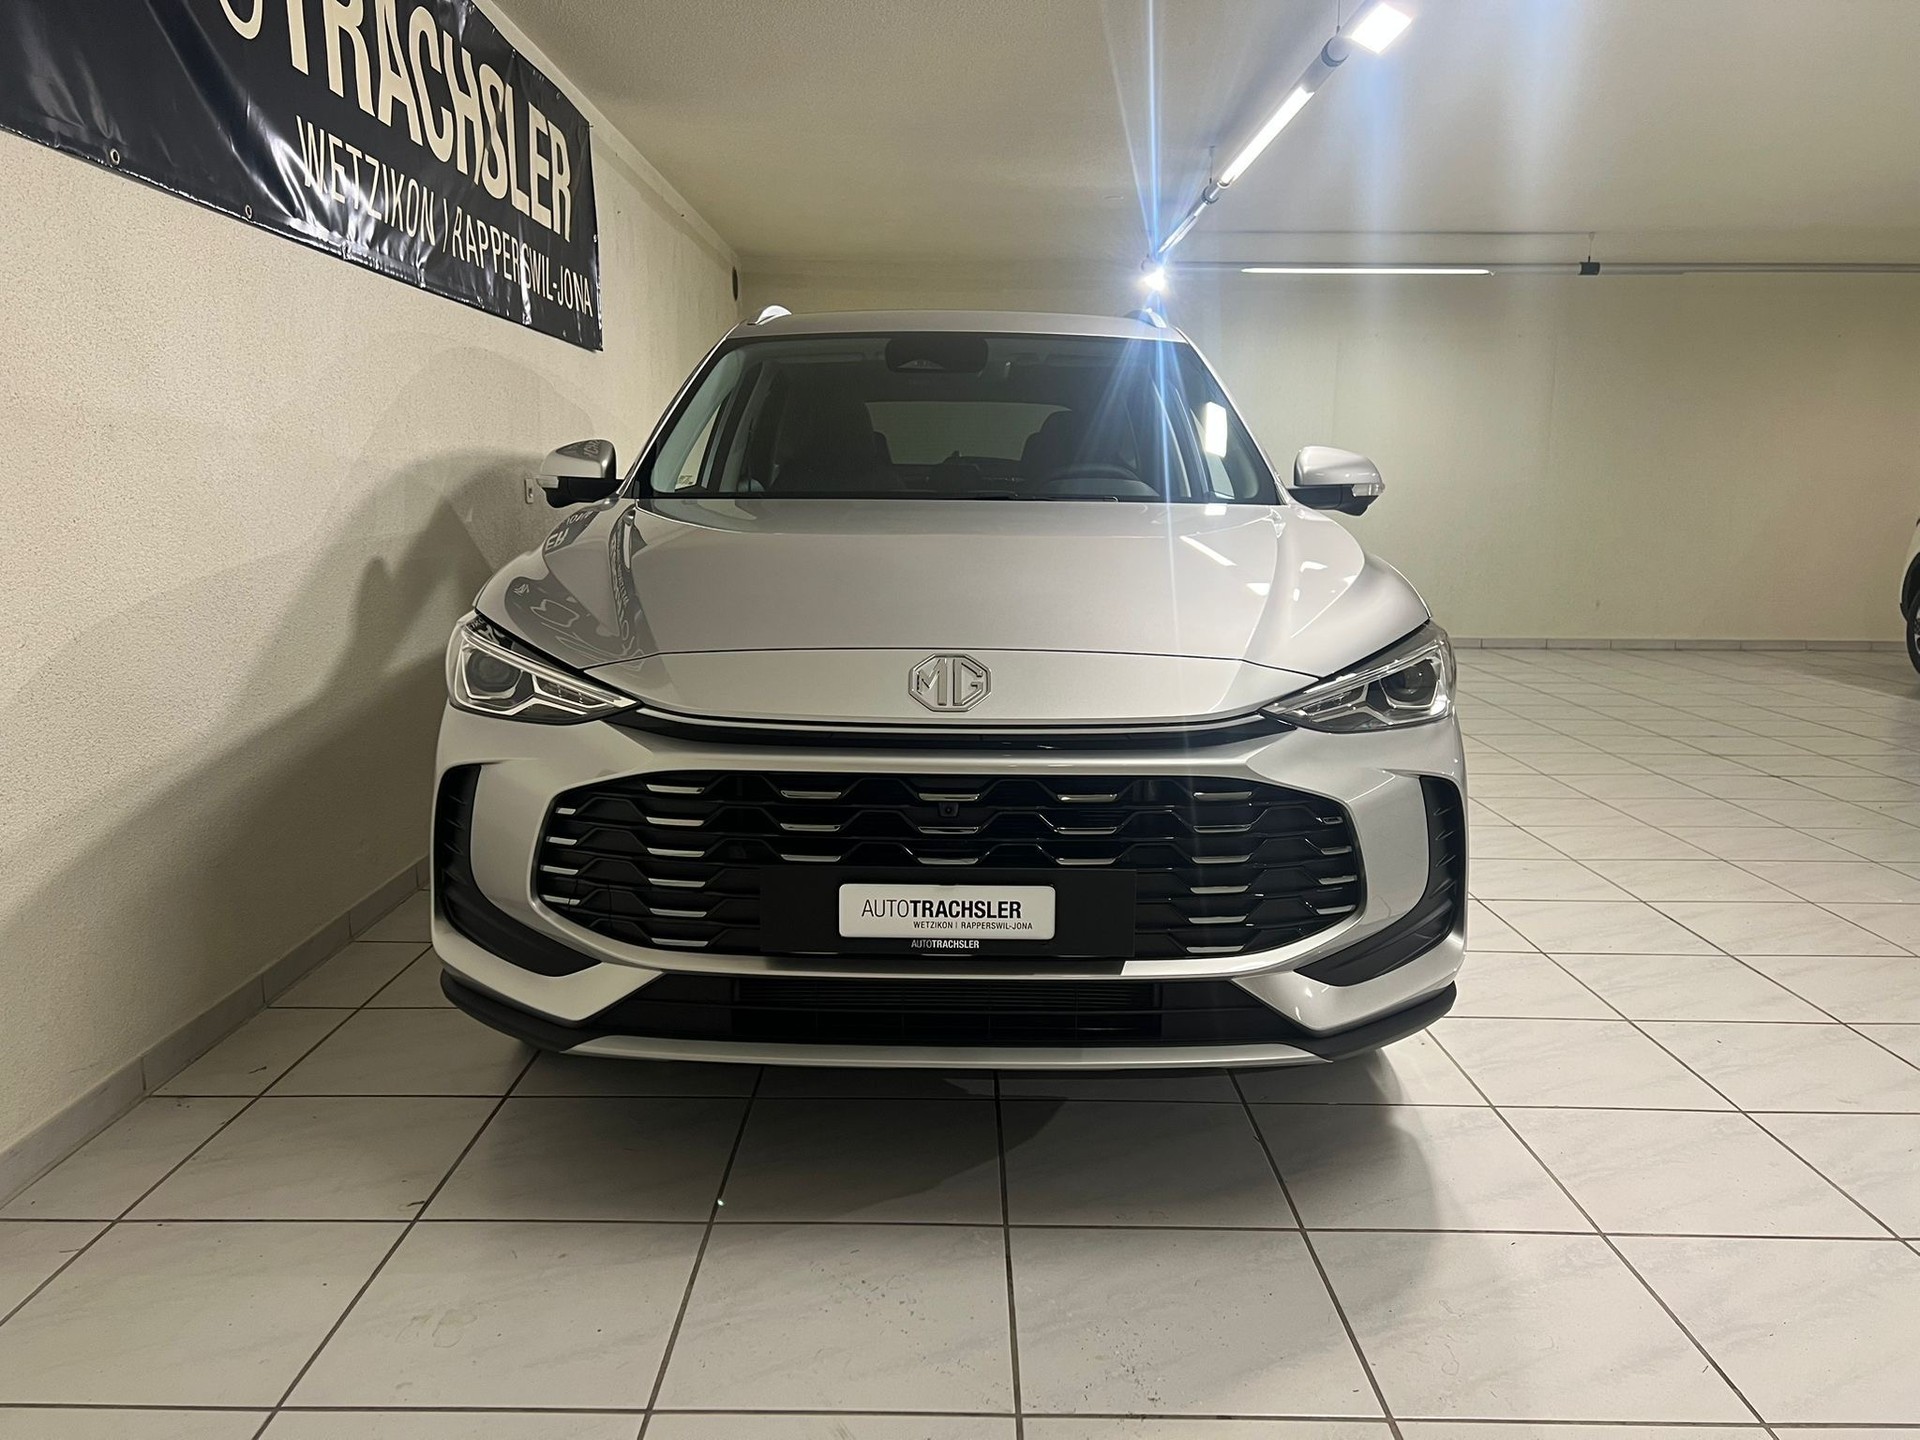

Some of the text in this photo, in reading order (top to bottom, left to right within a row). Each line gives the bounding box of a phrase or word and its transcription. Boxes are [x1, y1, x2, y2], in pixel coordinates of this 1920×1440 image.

[218, 0, 571, 241] RACHSLER
[296, 115, 436, 246] WETZIKON
[452, 206, 594, 317] RAPPERSWIL-JONA
[917, 658, 983, 706] MG
[861, 899, 1022, 919] AUTOTRACHSLER
[913, 921, 953, 929] WETZIKON
[960, 921, 1033, 931] RAPPERSWIL-JONA
[911, 939, 980, 949] AUTOTRACHSLER
